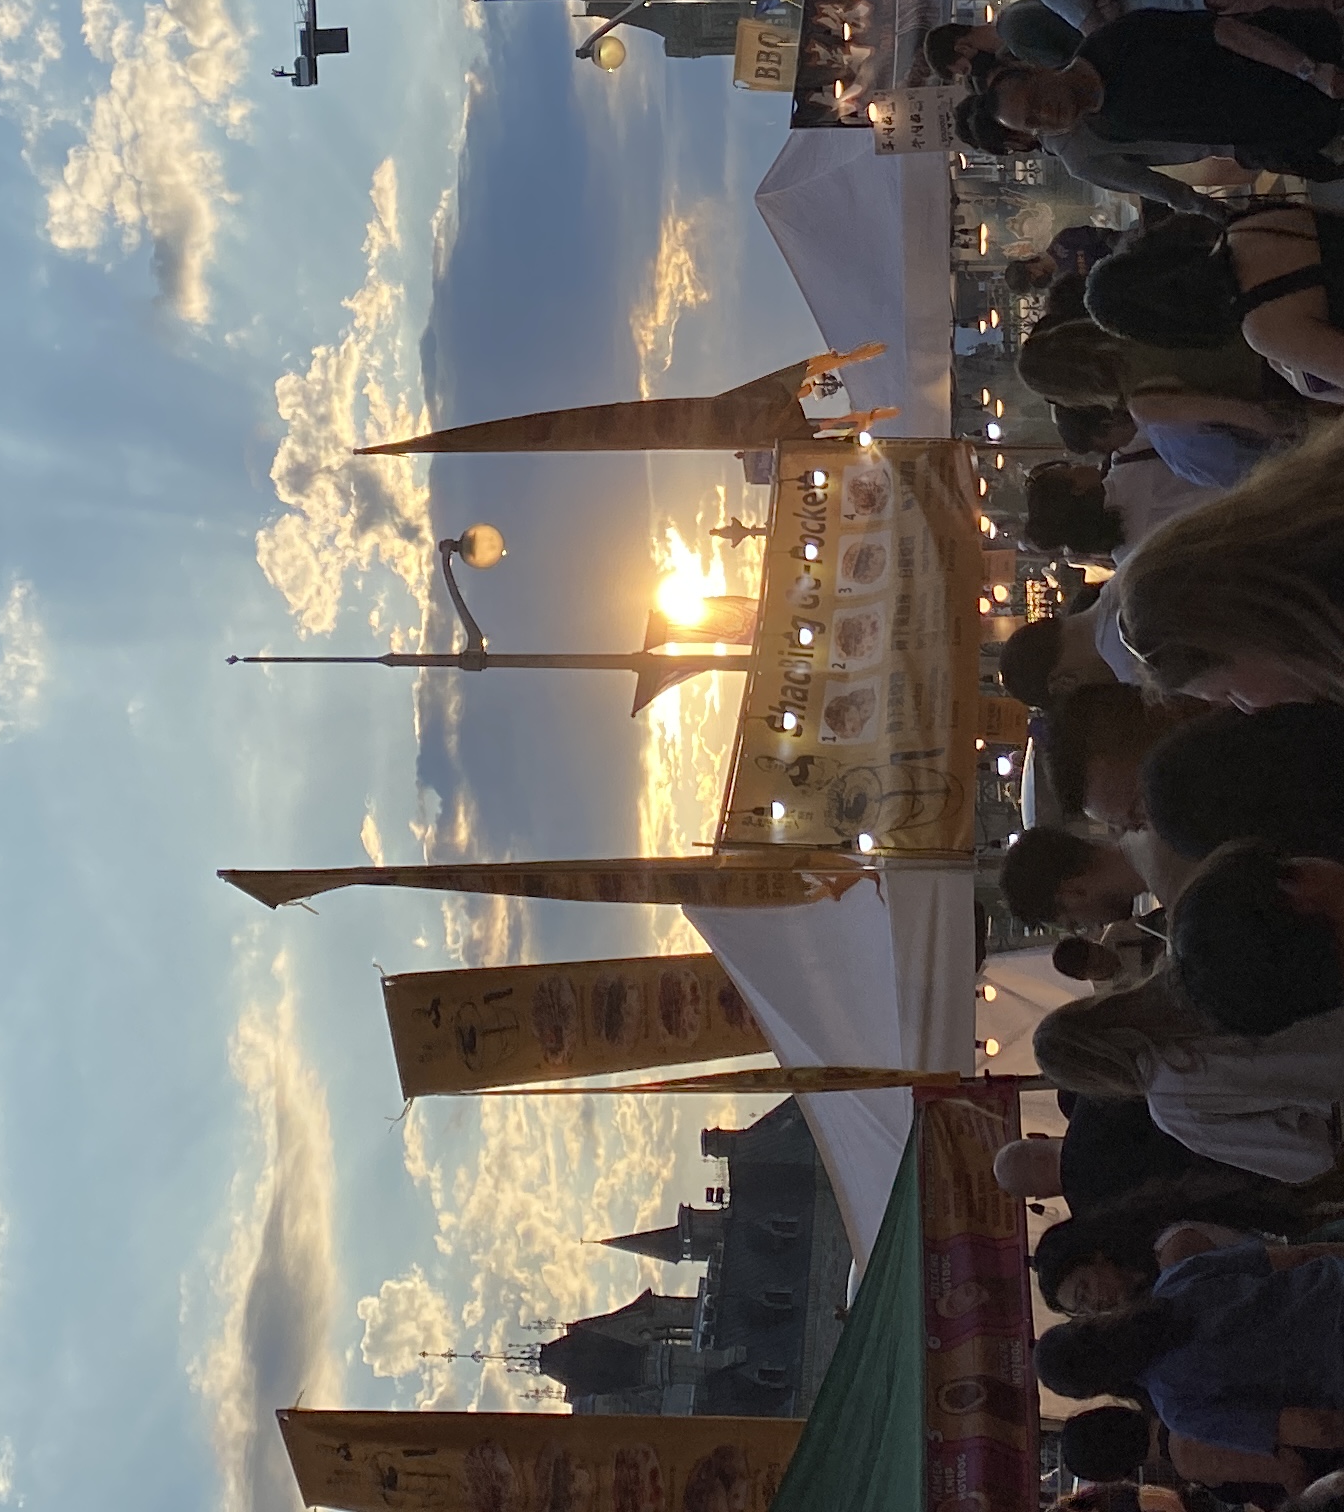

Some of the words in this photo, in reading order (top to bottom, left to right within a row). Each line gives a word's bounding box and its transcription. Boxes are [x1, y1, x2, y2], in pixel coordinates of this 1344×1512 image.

[754, 31, 783, 81] BBQ
[843, 513, 857, 521] 4
[838, 586, 852, 594] 3
[831, 662, 847, 670] 2
[1010, 1339, 1023, 1385] HOTDOG
[956, 1453, 967, 1501] HOTDOG
